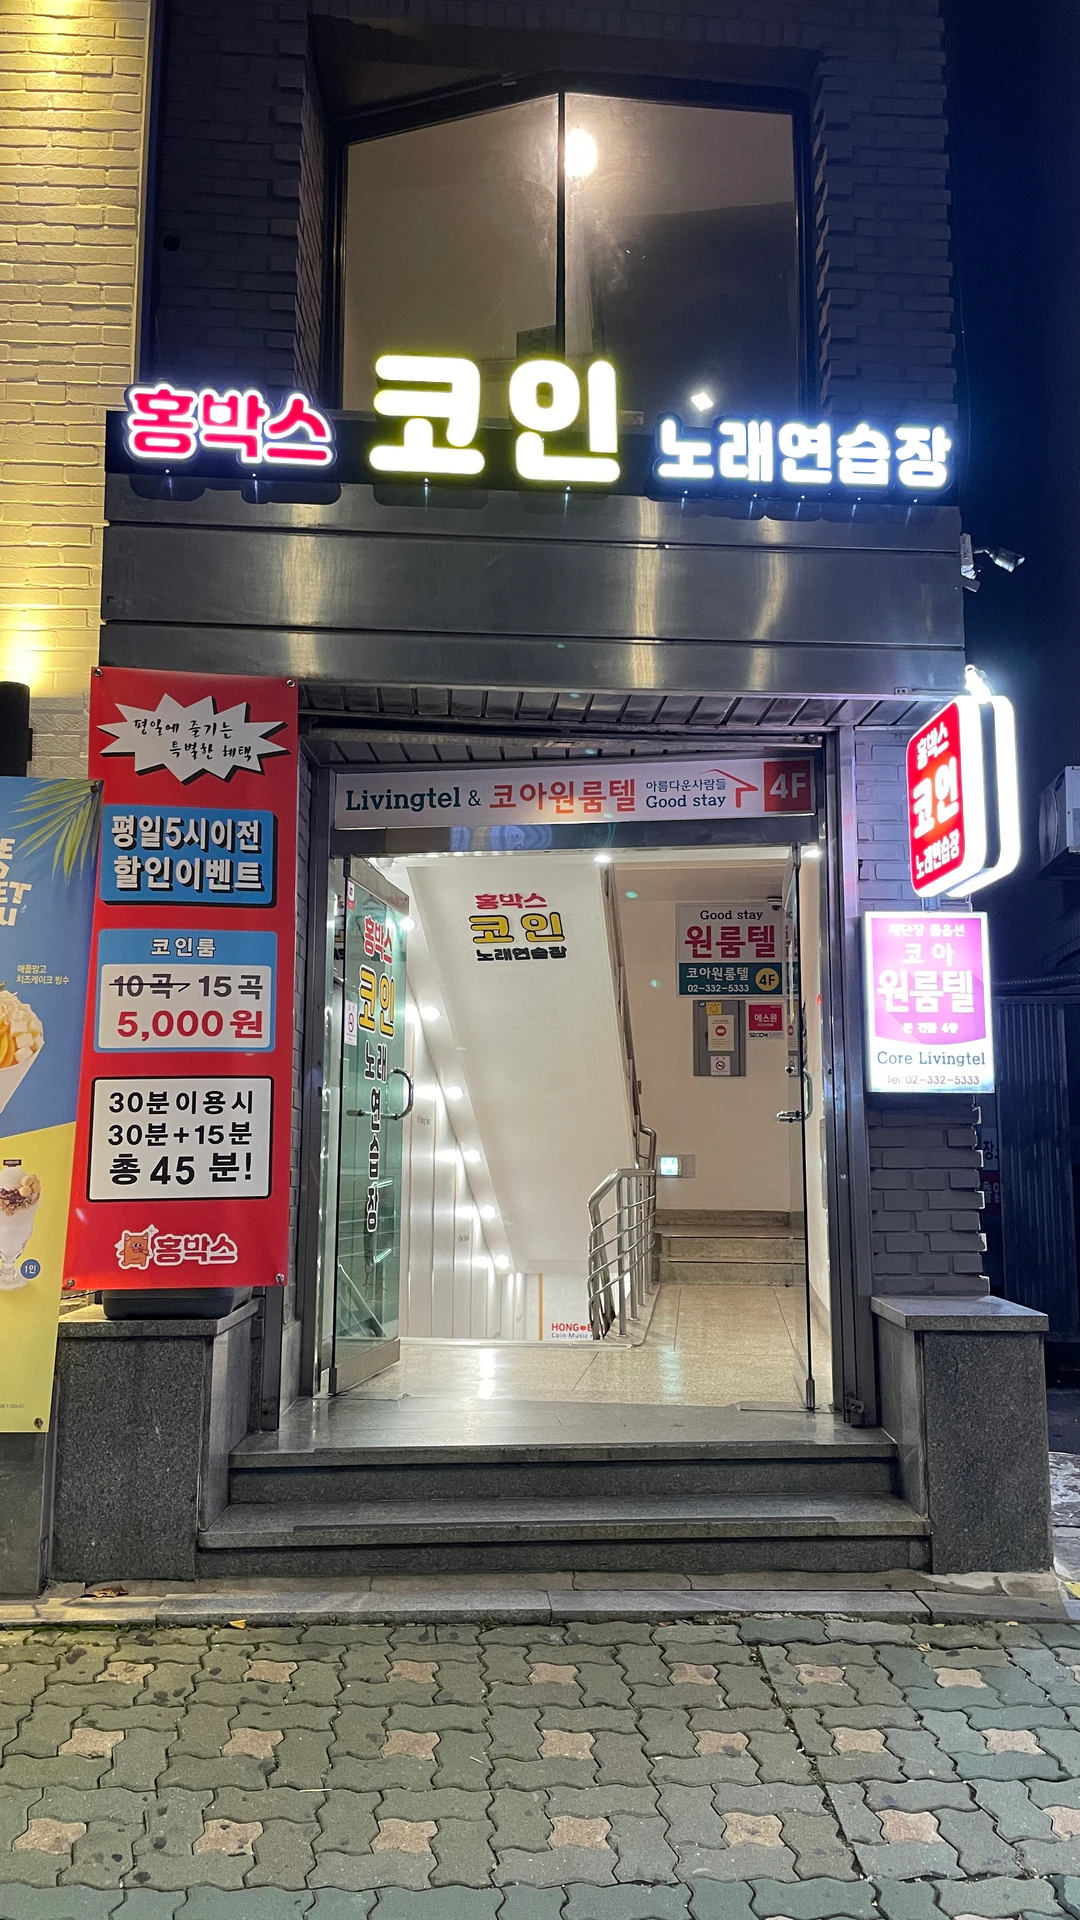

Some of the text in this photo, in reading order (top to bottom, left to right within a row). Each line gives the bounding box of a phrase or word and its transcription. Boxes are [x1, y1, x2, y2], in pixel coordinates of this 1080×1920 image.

[128, 354, 951, 488] 홍박스 코인 노래연습장
[133, 718, 234, 740] 평일에 즐기는
[169, 740, 252, 762] 특별한 혜택
[916, 721, 950, 770] 홍박스
[345, 778, 635, 814] Livingtel & 코아원룸텔
[645, 775, 727, 793] 아름다운사람들
[768, 771, 807, 799] 4F
[645, 792, 727, 810] Good stay
[912, 756, 960, 839] 코인
[111, 814, 261, 852] 평일5시이전
[915, 828, 960, 880] 노래연습장
[113, 855, 262, 891] 할인이벤트
[474, 892, 548, 910] 홍박스
[469, 911, 565, 944] 코인
[700, 909, 764, 921] Good stay
[150, 936, 216, 959] 코인룸
[364, 914, 393, 965] 홍박스
[684, 925, 776, 959] 원룸텔
[476, 945, 568, 961] 노래연습장
[902, 942, 955, 967] 코아
[16, 964, 47, 975] 애플망고
[16, 975, 53, 984] 치즈케이크
[686, 966, 749, 981] 코아원룸텔
[758, 974, 775, 986] 4F
[687, 984, 750, 993] 02-332-5333
[876, 968, 975, 1014] 원룸텔
[359, 964, 395, 1039] 코인
[117, 1009, 264, 1042] 5,000원
[754, 1013, 778, 1024] 에스원
[877, 1050, 985, 1067] Core Livingtel
[905, 1075, 980, 1085] 02-332-5333
[109, 1090, 254, 1116] 30분이용시
[107, 1120, 253, 1146] 30분+15분
[109, 1153, 141, 1185] 총
[153, 1232, 238, 1266] 홍박스
[25, 1264, 37, 1274] 1인
